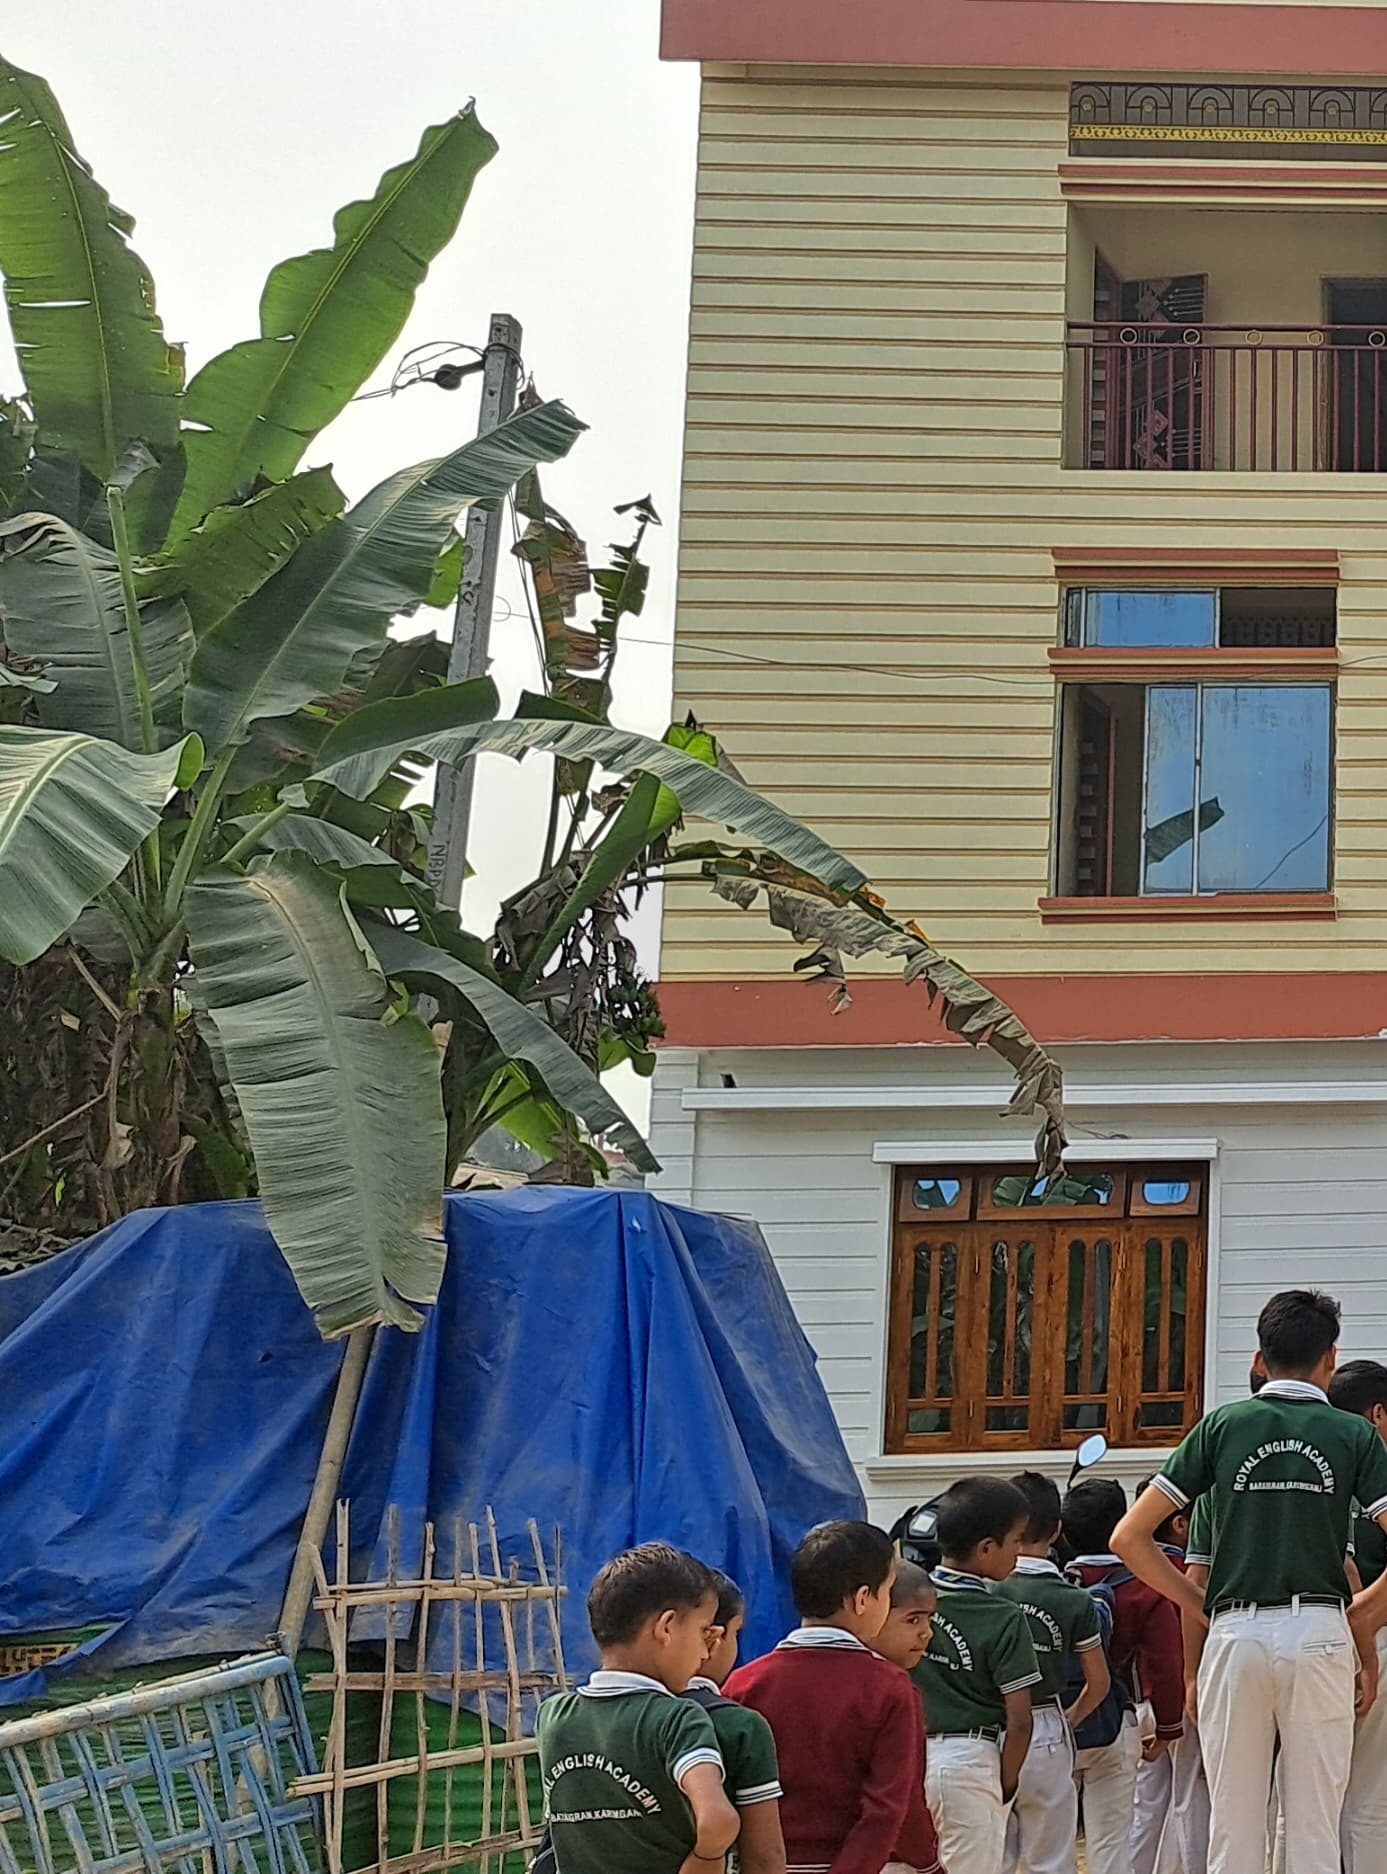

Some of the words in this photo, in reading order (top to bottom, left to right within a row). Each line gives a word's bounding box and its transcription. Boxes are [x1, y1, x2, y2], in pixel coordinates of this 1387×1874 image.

[1233, 1455, 1259, 1492] ROYAL
[1257, 1439, 1304, 1459] ENGLISH
[1301, 1443, 1336, 1495] ACADEMY
[943, 1623, 974, 1672] ACADEMY
[1036, 1610, 1064, 1652] ACADEMY
[551, 1754, 605, 1779] ENGLISH
[604, 1761, 662, 1815] ACADEMY
